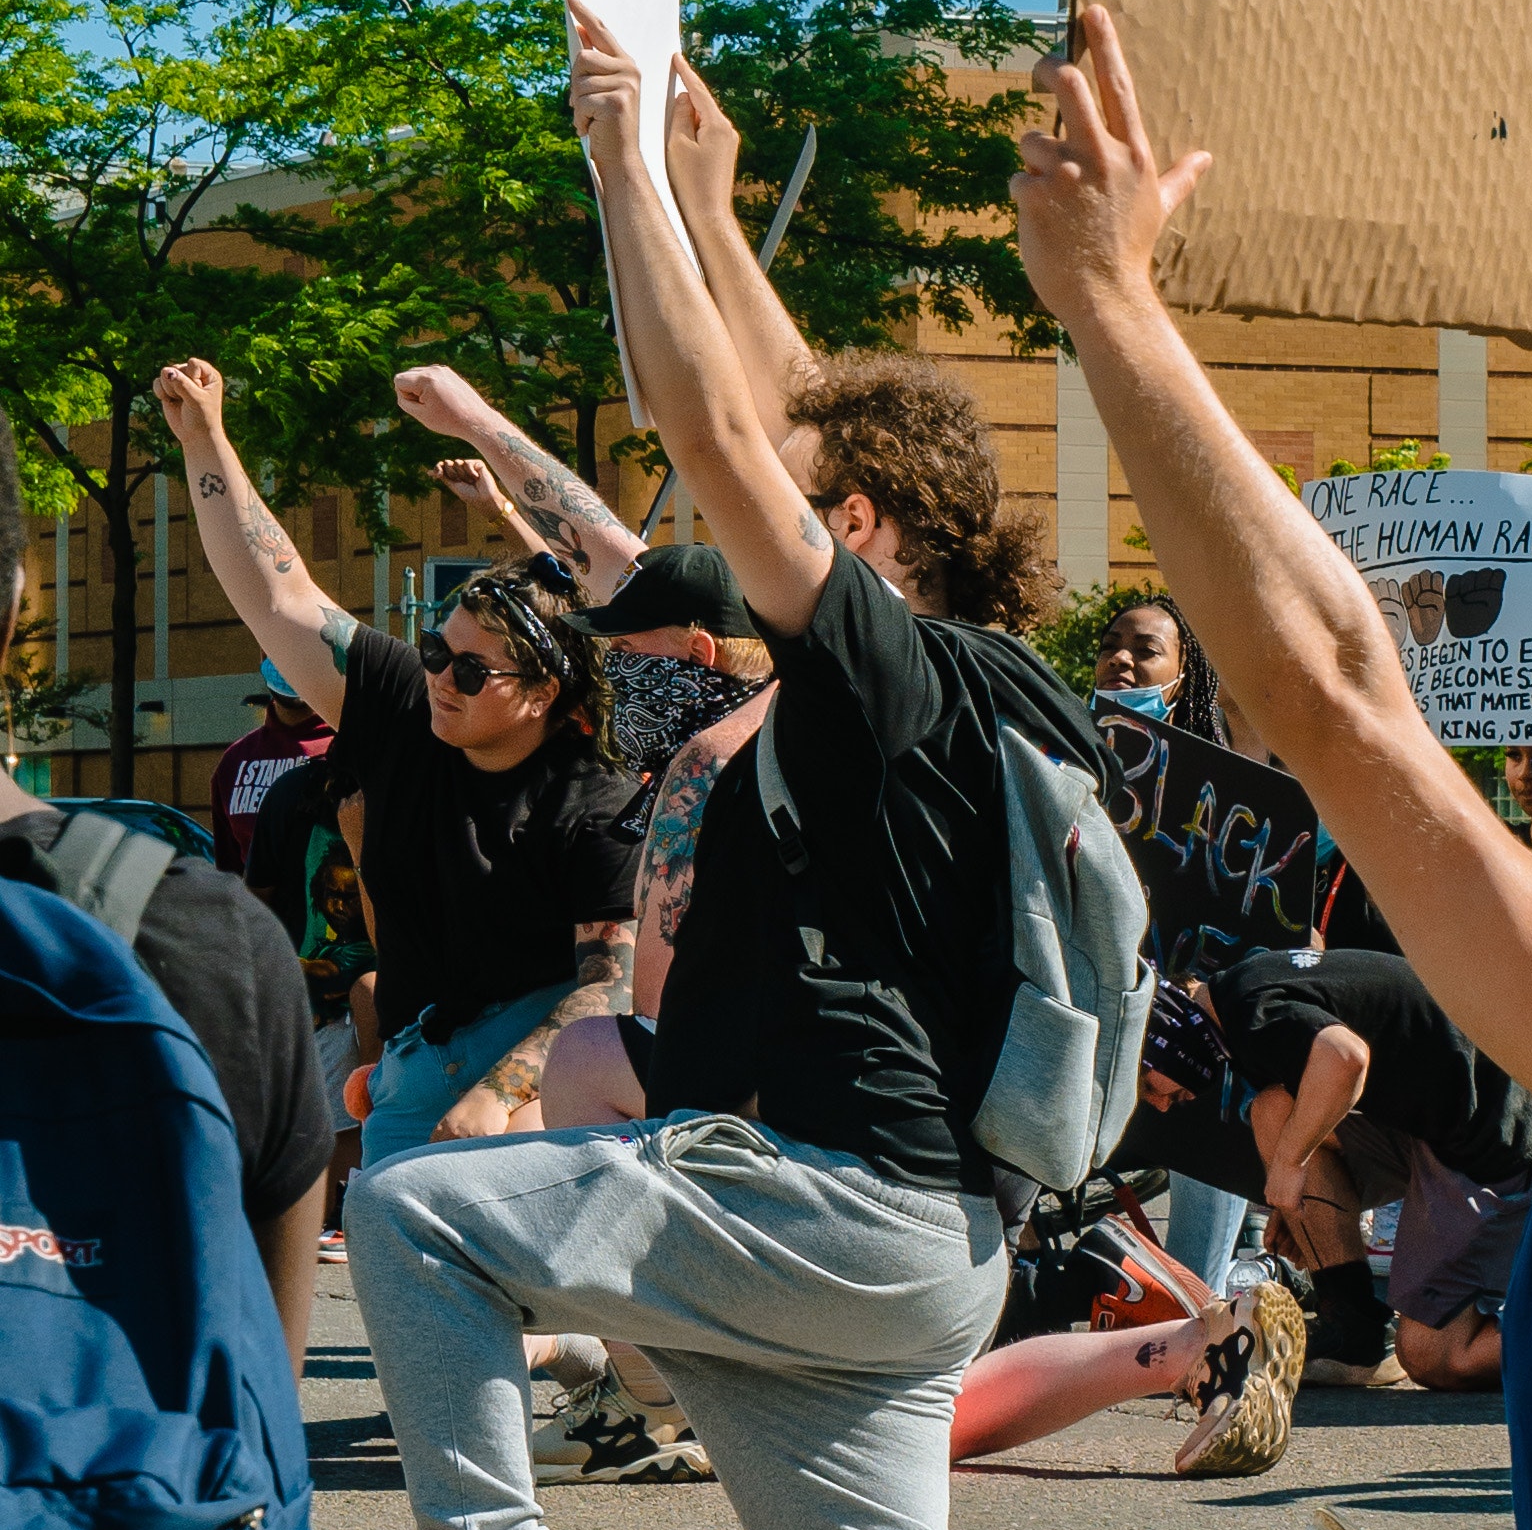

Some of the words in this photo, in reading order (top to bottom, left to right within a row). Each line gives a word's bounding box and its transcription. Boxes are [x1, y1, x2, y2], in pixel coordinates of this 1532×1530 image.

[1312, 476, 1359, 521] ONE
[1327, 523, 1369, 563] THE
[1377, 520, 1483, 559] HUMAN
[1419, 640, 1472, 670] BEGIN
[1479, 638, 1508, 663] TO
[1430, 665, 1512, 692] BECOME
[1435, 692, 1477, 711] THAT
[235, 761, 247, 785] I
[1098, 715, 1311, 931] BLACK
